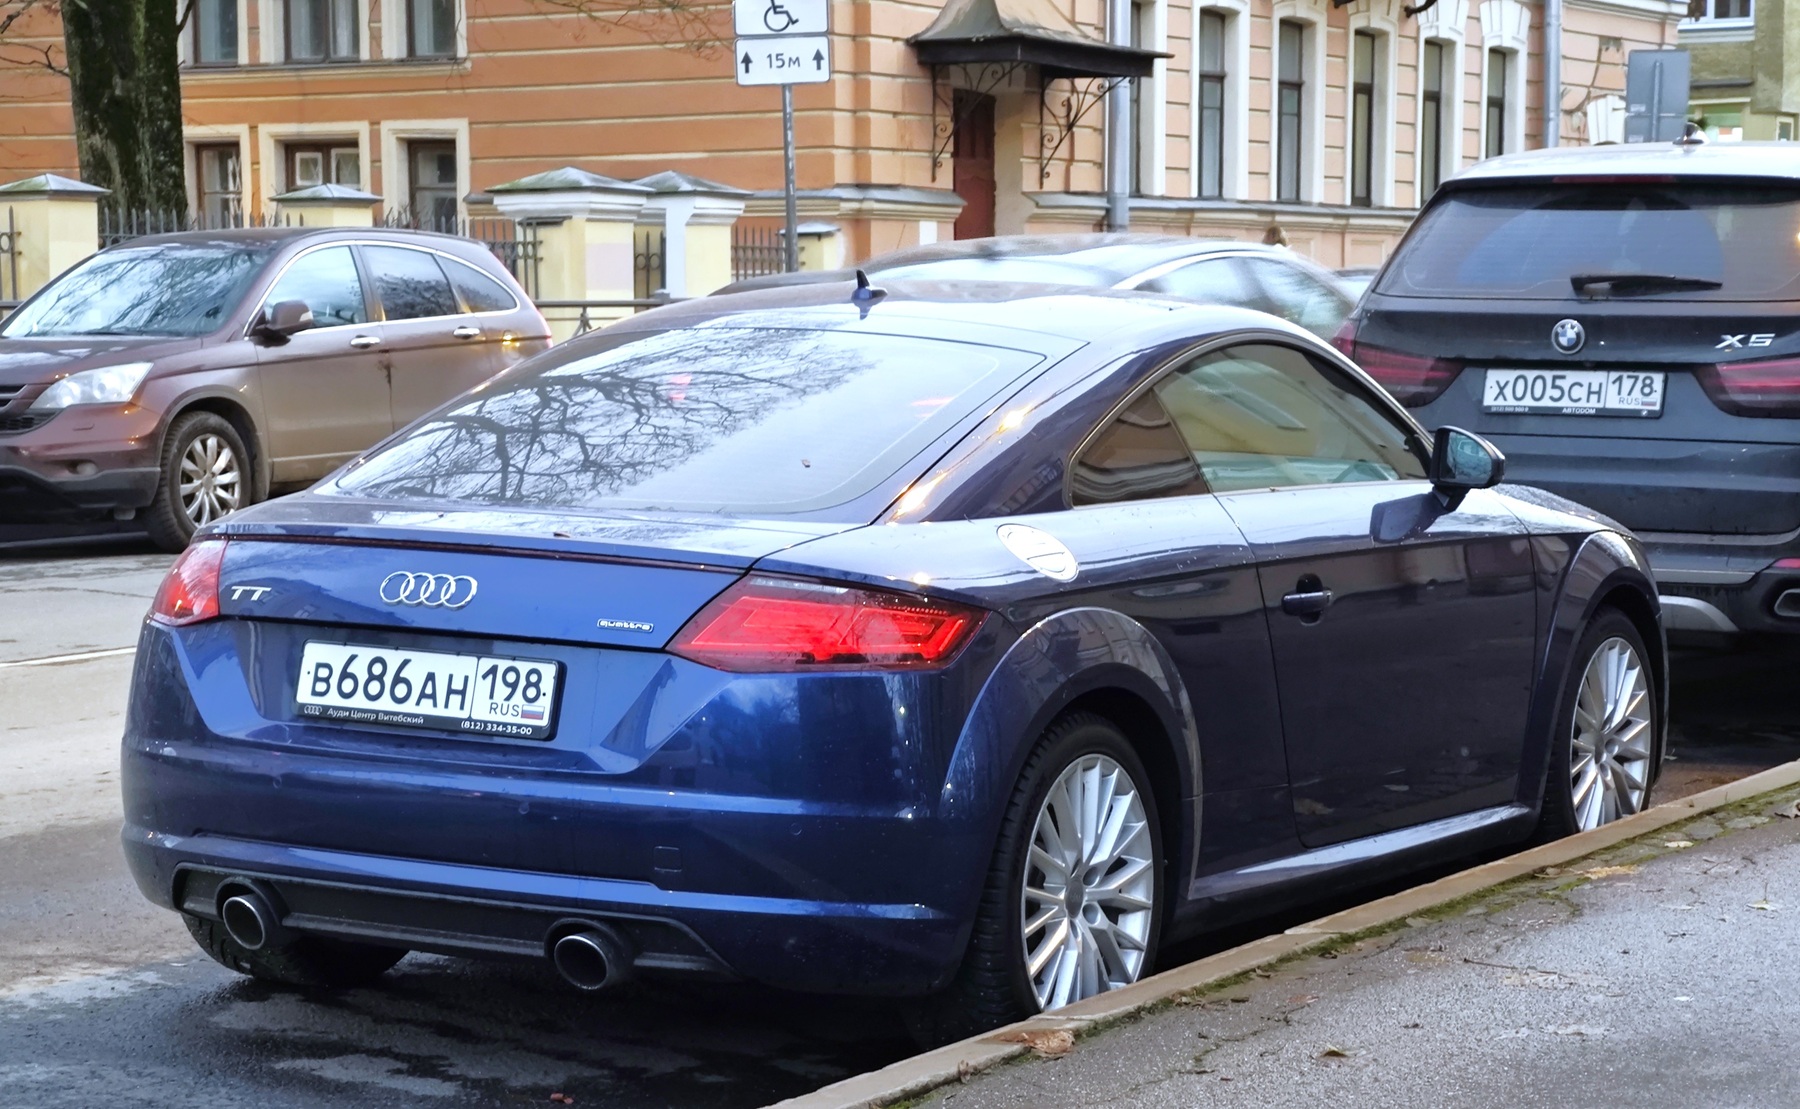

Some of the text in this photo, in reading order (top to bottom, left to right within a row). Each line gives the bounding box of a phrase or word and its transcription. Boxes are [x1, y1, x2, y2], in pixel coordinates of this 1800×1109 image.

[1714, 333, 1776, 349] X5
[1493, 374, 1655, 403] Х005СН 178
[1618, 396, 1640, 406] RUS
[231, 585, 272, 601] TT
[599, 620, 651, 631] quattro
[310, 654, 543, 711] В686АН 198
[327, 707, 424, 724] Ауди Центр Витебский
[489, 702, 520, 717] RUS
[461, 720, 532, 735] (812) 334-35-00
